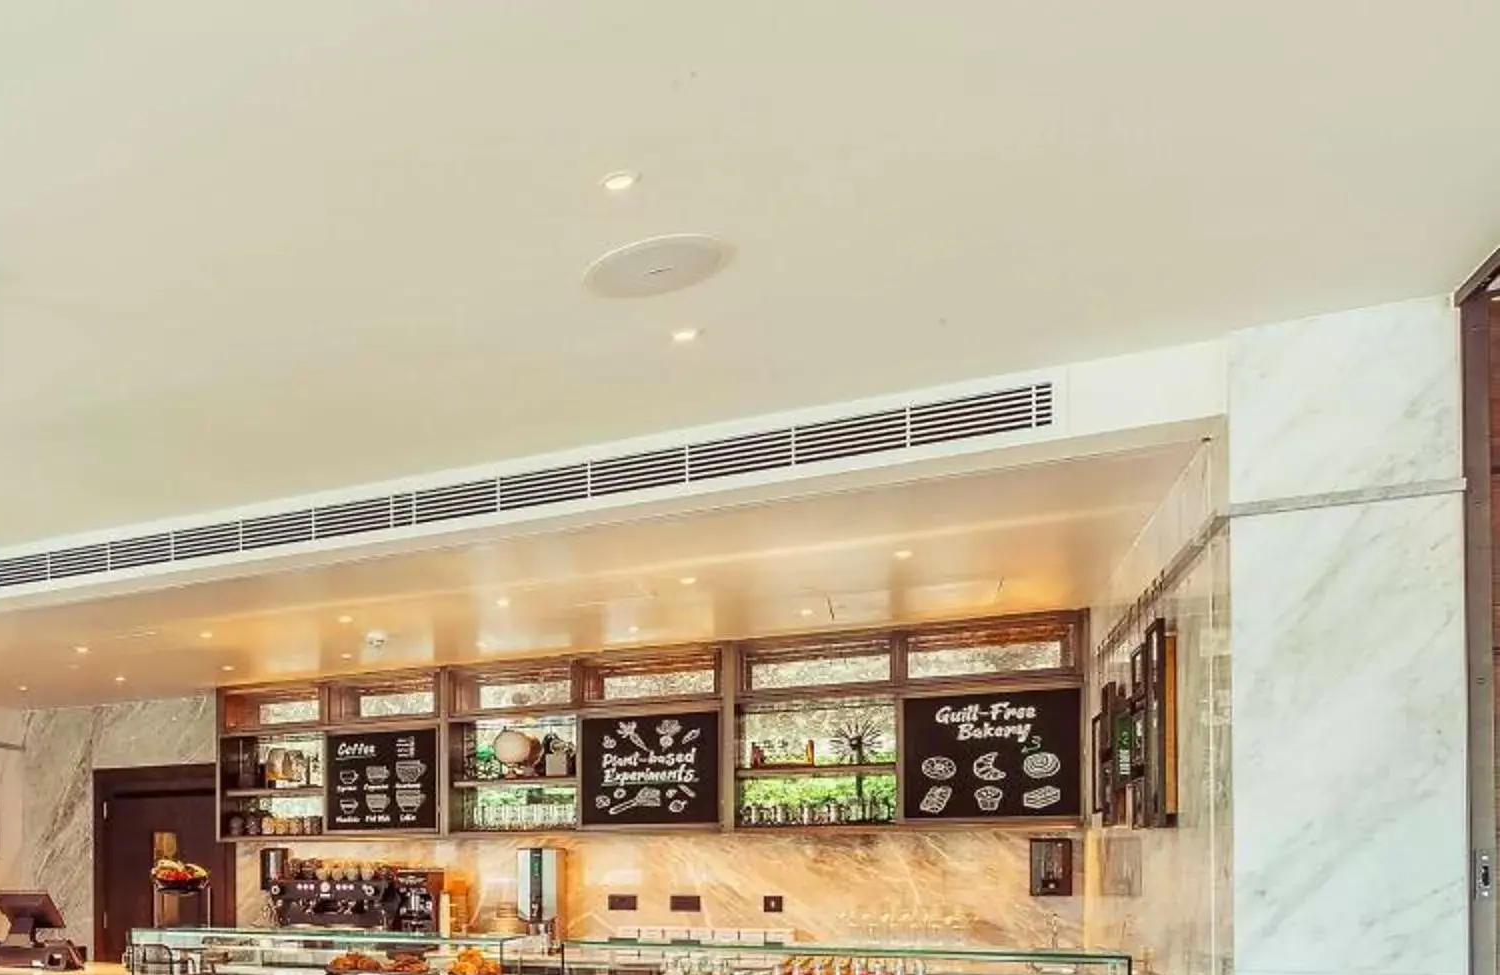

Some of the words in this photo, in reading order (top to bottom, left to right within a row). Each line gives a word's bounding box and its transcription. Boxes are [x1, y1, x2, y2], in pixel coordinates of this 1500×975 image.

[935, 701, 1037, 724] Guilt-Free
[956, 723, 1032, 743] Bakery
[337, 742, 376, 756] Coffee
[601, 747, 696, 768] Plant-based
